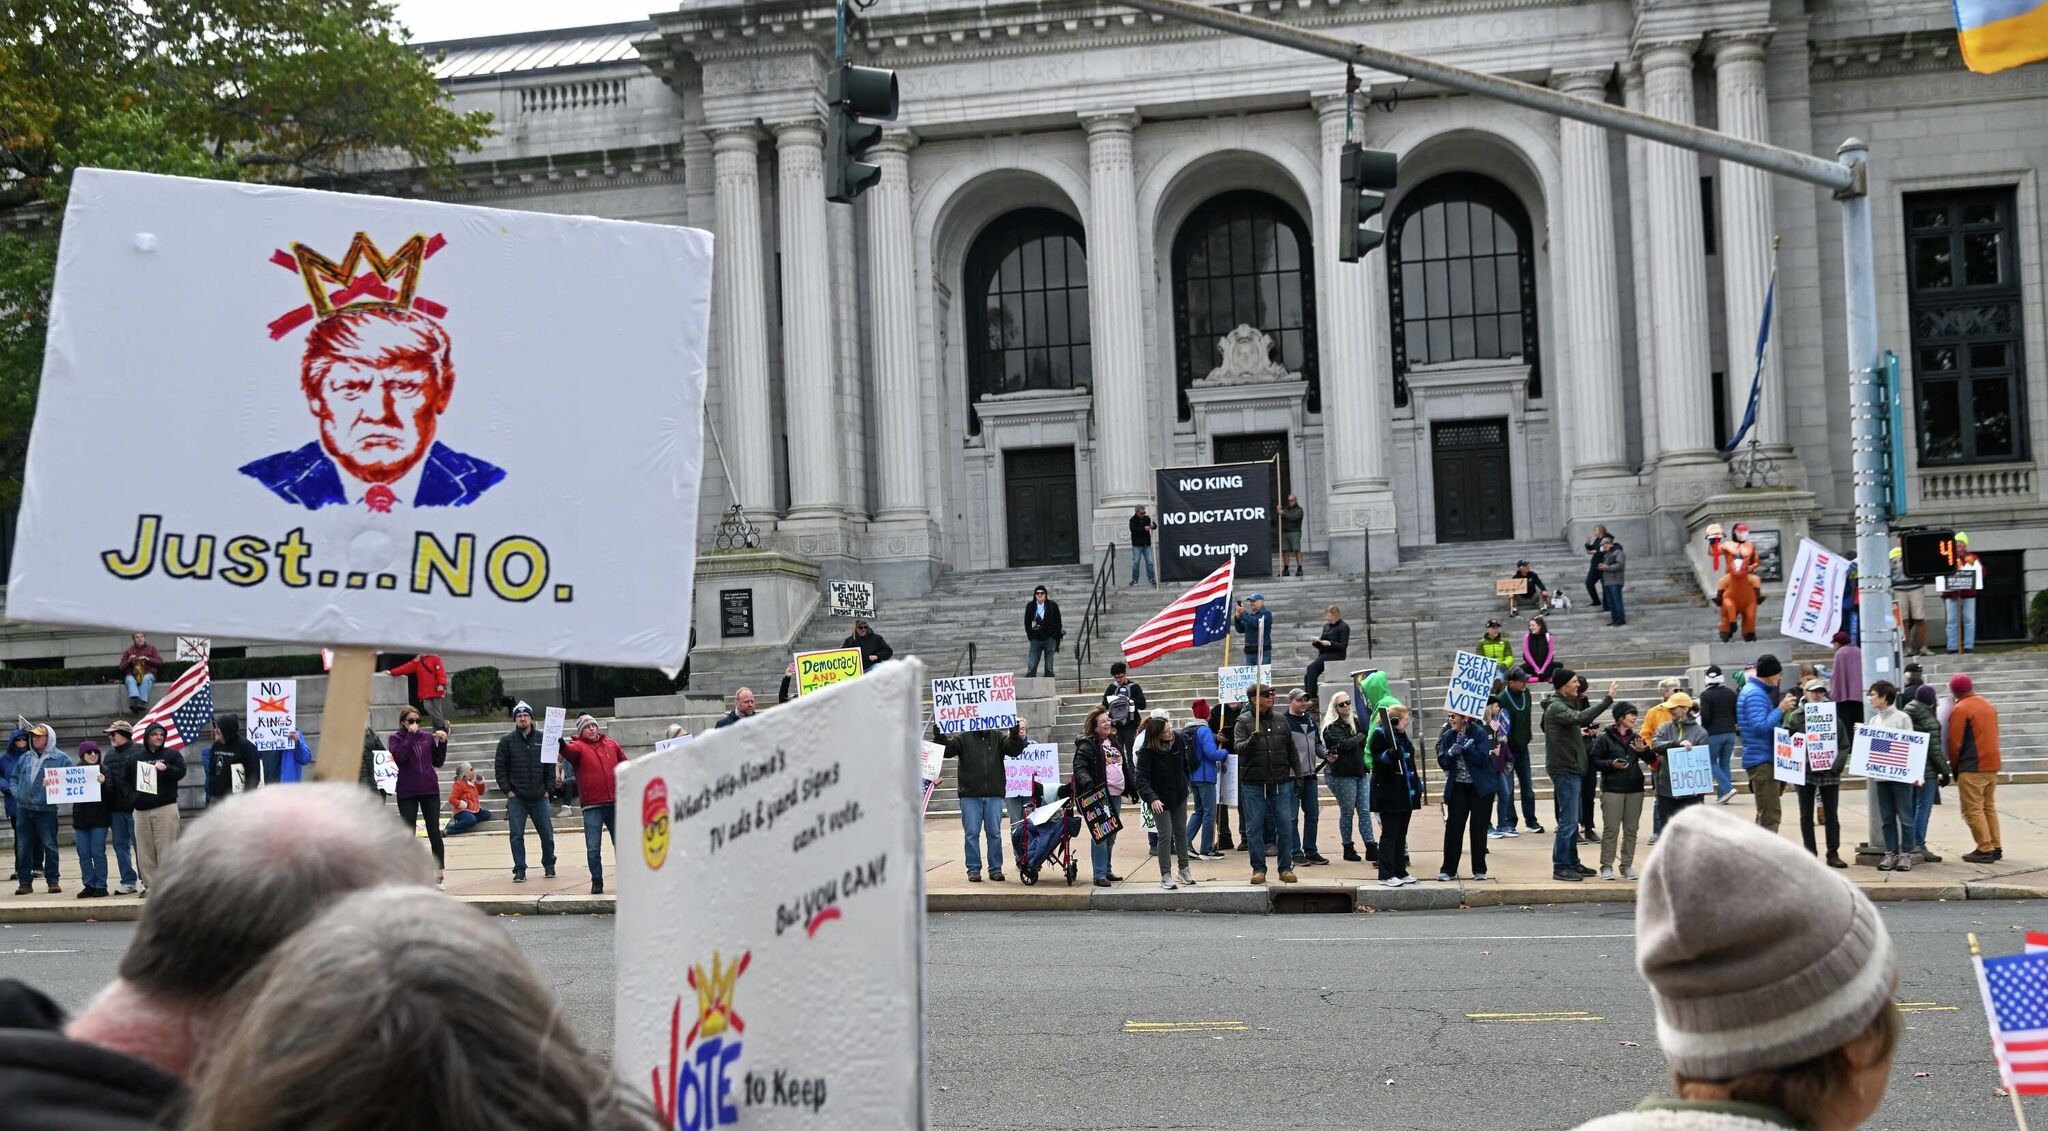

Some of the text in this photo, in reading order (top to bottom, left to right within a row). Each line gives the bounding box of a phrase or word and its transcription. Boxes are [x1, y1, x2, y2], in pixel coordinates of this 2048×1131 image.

[1179, 475, 1243, 492] NO KING
[1163, 507, 1265, 525] NO DICTATOR
[1179, 543, 1248, 557] NO trump
[1939, 540, 1954, 566] 4
[831, 583, 869, 593] WE WILL
[802, 655, 858, 677] Democracy
[1233, 666, 1256, 674] VOTE
[1457, 652, 1497, 672] EXERT
[812, 672, 837, 682] AND
[934, 675, 1015, 693] MAKE THE RICH
[1458, 666, 1493, 684] YOUR
[260, 681, 282, 696] NO
[1452, 677, 1491, 698] POWER
[936, 688, 1015, 707] PAY THEIR FAIR
[1449, 690, 1487, 717] VOTE
[940, 705, 979, 720] SHARE
[257, 716, 293, 728] KINGS
[939, 714, 1018, 734] VOTE DEMOCRAT
[270, 728, 290, 738] WE
[1859, 727, 1924, 745] REJECTING KINGS
[1011, 749, 1052, 762] MOCRAT
[1866, 763, 1887, 774] SINCE
[65, 786, 84, 796] ICE
[710, 824, 727, 854] TV
[729, 808, 752, 842] ads
[767, 778, 799, 830] yard
[802, 761, 840, 802] signs
[776, 896, 801, 936] But
[842, 852, 887, 898] CAN!
[744, 1070, 767, 1106] to
[773, 1068, 827, 1113] Keep
